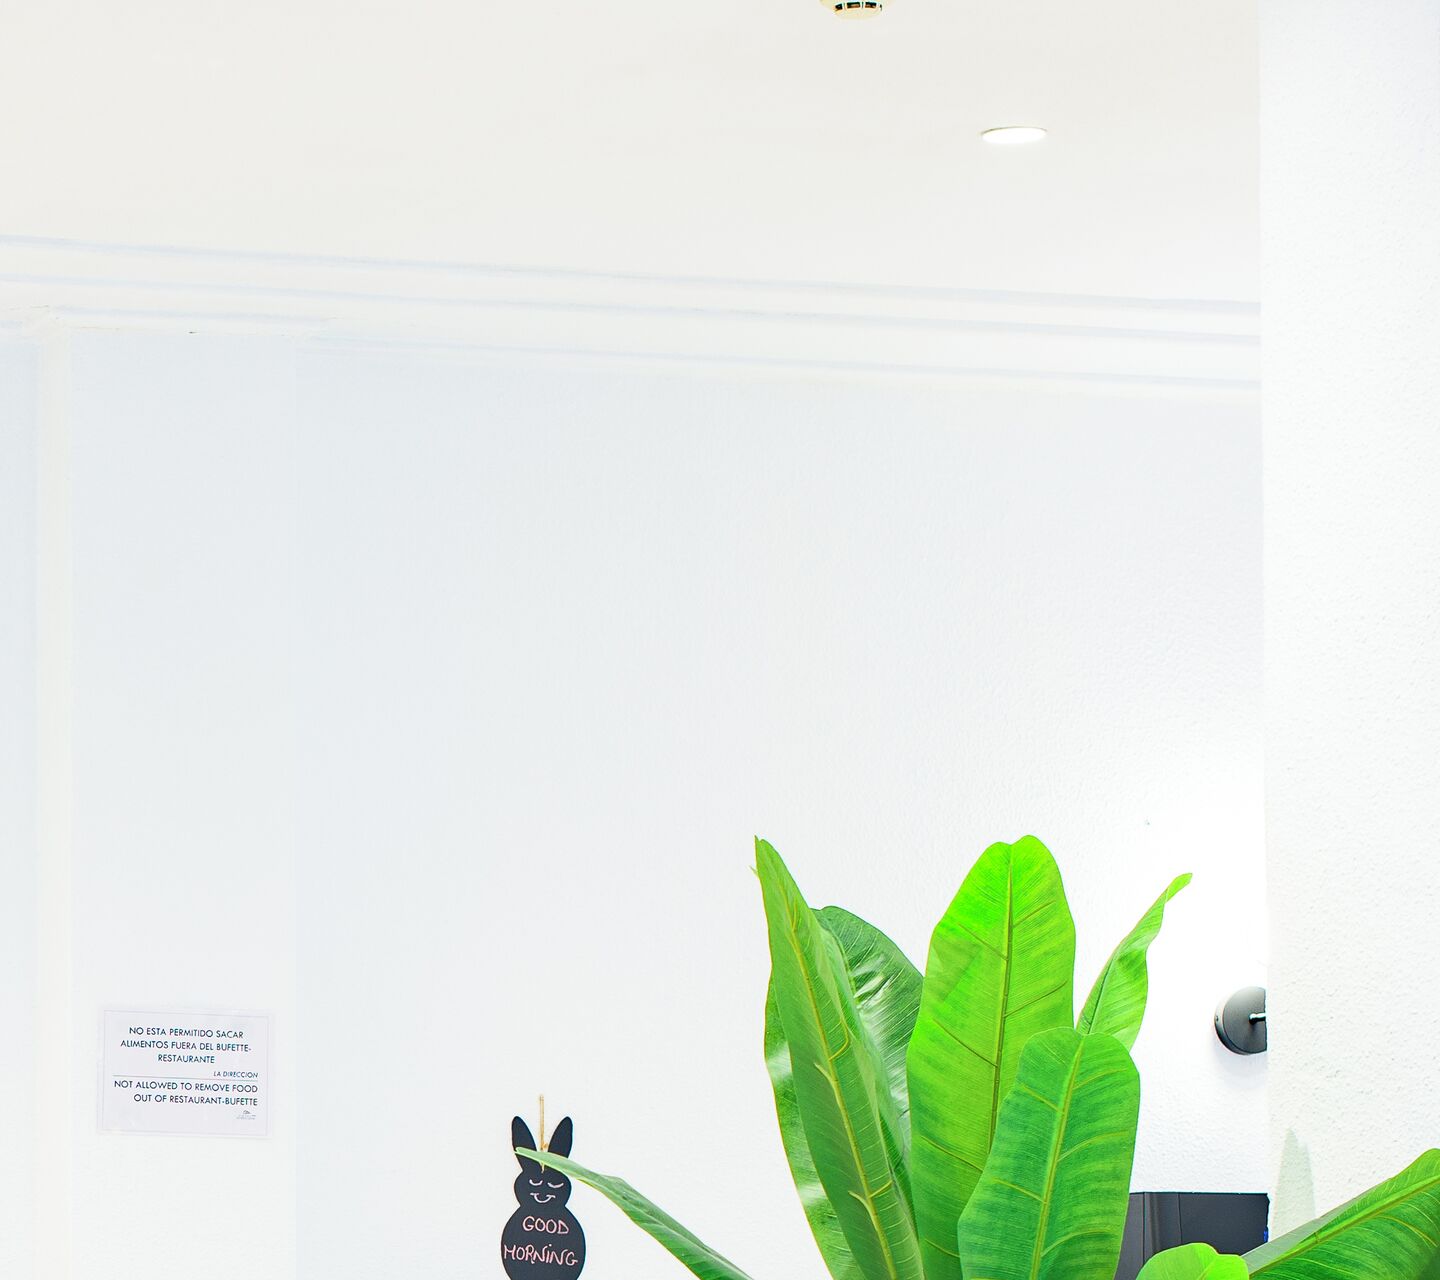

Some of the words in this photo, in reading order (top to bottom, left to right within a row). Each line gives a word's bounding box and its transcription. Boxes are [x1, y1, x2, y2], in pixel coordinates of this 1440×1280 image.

[129, 1027, 144, 1035] NO
[146, 1027, 167, 1036] ESTA
[169, 1028, 214, 1038] PERMITIDO
[216, 1030, 244, 1039] SACAR
[120, 1040, 169, 1049] ALIMENTOS
[171, 1041, 197, 1050] FUERA
[199, 1042, 214, 1051] DEL
[216, 1043, 252, 1052] BUFETTE-
[157, 1053, 215, 1064] RESTAURANTE
[114, 1080, 133, 1088] NOT
[135, 1081, 178, 1090] ALLOWED
[180, 1082, 192, 1091] TO
[195, 1083, 230, 1092] REMOVE
[232, 1084, 258, 1093] FOOD
[133, 1093, 152, 1102] OUT
[154, 1094, 167, 1103] OF
[169, 1095, 258, 1106] RESTAURANT-BUFETTE
[522, 1215, 570, 1235] GOOD
